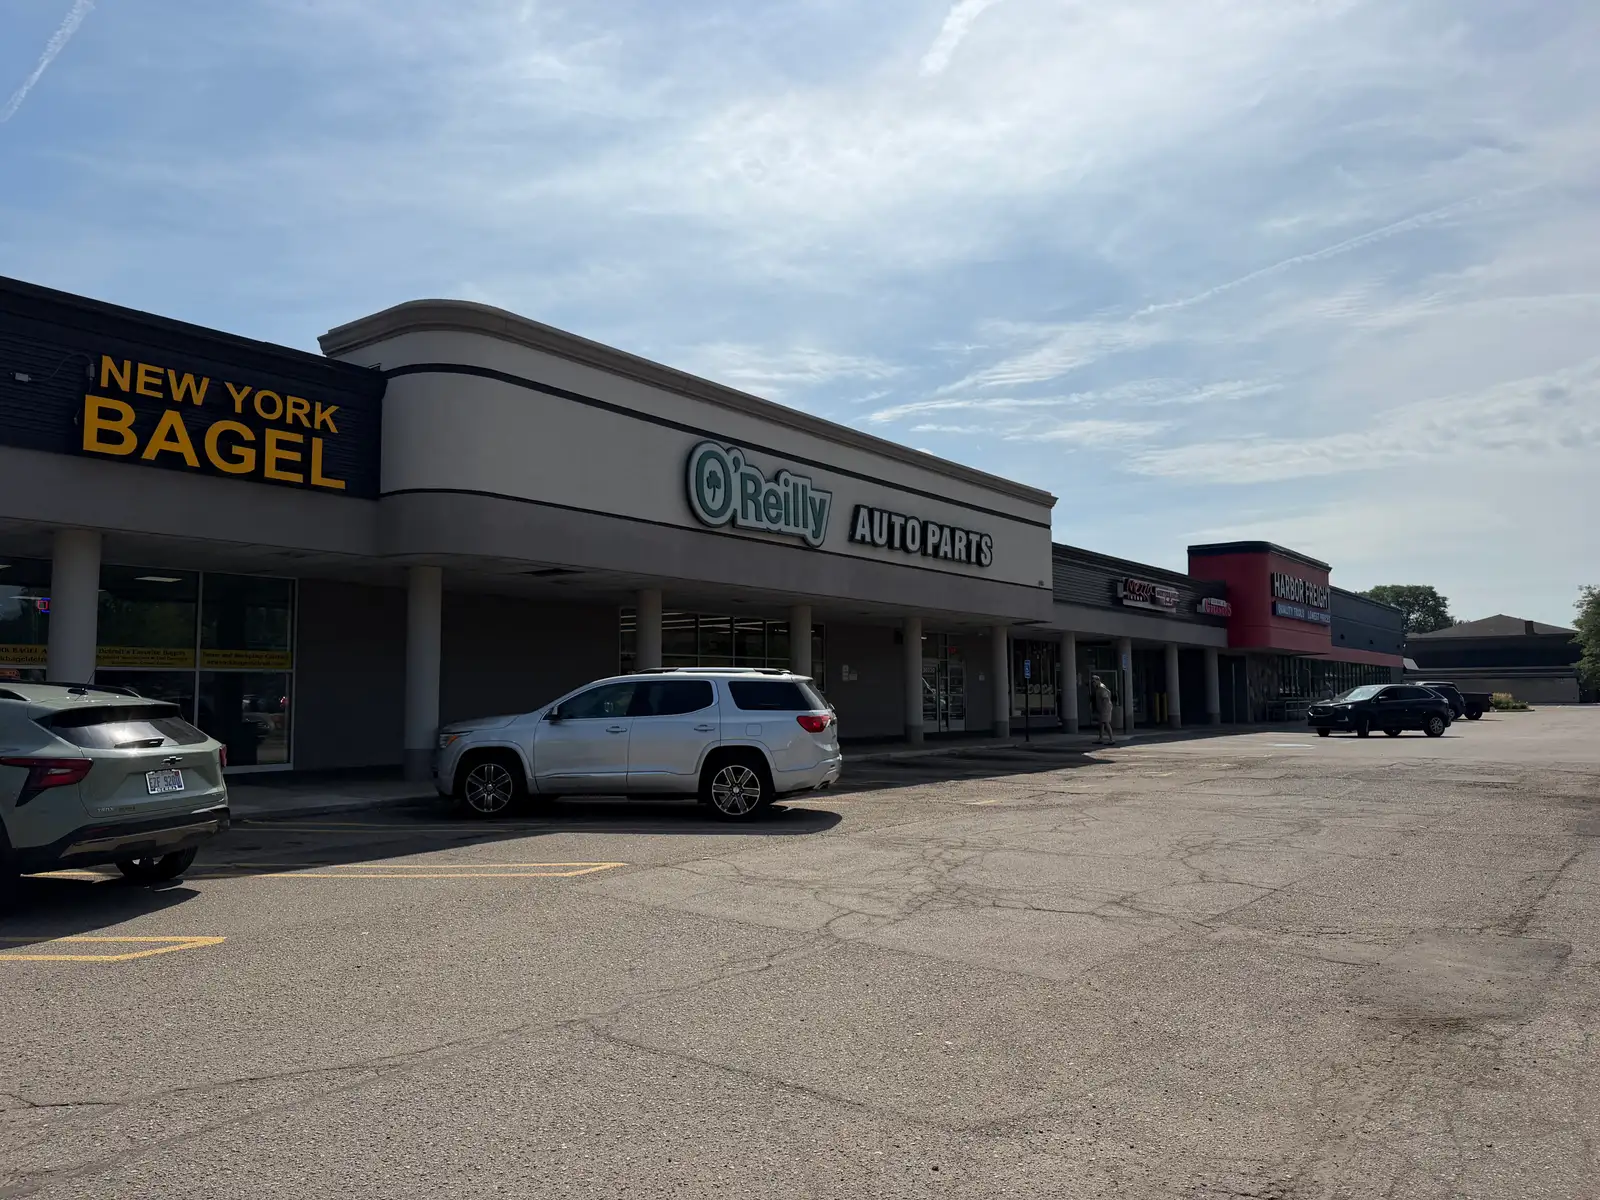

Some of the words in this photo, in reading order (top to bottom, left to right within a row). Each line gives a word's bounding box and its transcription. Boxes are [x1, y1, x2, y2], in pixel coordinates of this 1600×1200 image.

[100, 355, 209, 406] NEW
[225, 381, 340, 433] YORK
[82, 394, 346, 490] BAGEL
[695, 449, 827, 540] O'Reilly
[855, 506, 922, 552] AUTO
[927, 524, 993, 567] PARTS
[1273, 571, 1304, 604] HARBOR
[1305, 581, 1331, 609] FREIGHT
